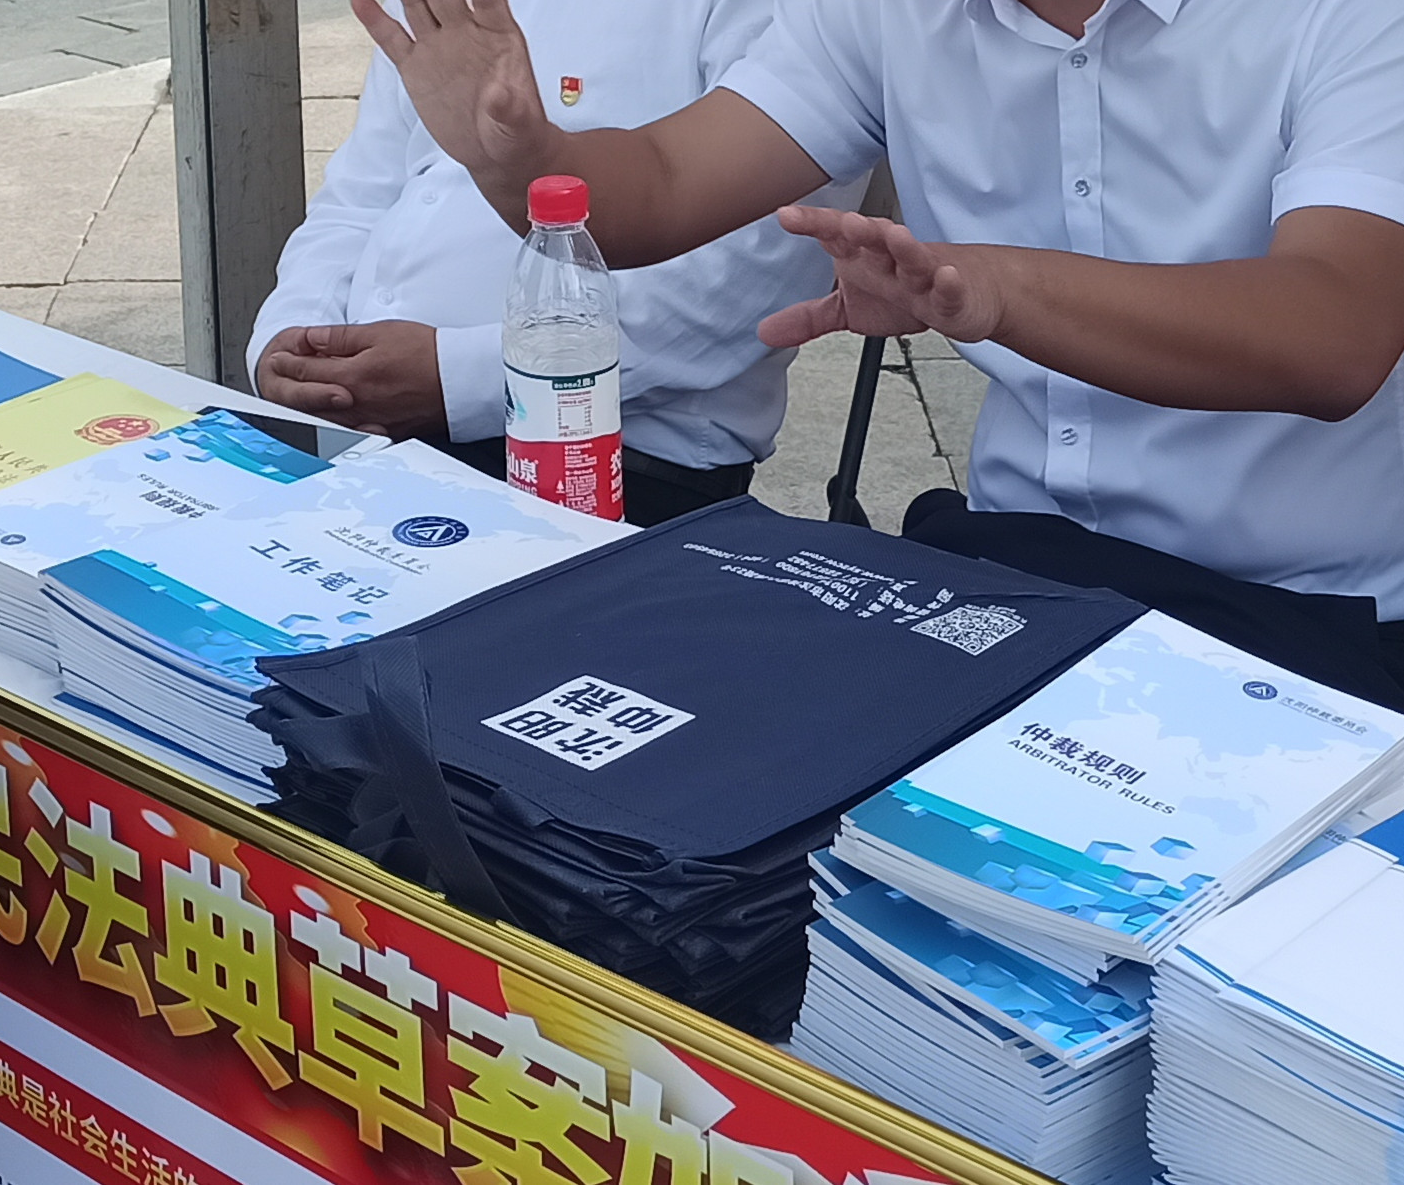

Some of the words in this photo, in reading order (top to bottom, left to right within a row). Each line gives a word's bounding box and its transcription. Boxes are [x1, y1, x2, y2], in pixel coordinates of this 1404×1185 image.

[506, 451, 538, 485] 山泉
[248, 539, 389, 605] 工作笔记
[499, 710, 624, 762] 沈阳
[552, 681, 673, 735] 仲裁
[1007, 739, 1113, 790] ARBITRATOR
[1117, 787, 1176, 815] RULES
[1020, 722, 1147, 785] 仲裁规则
